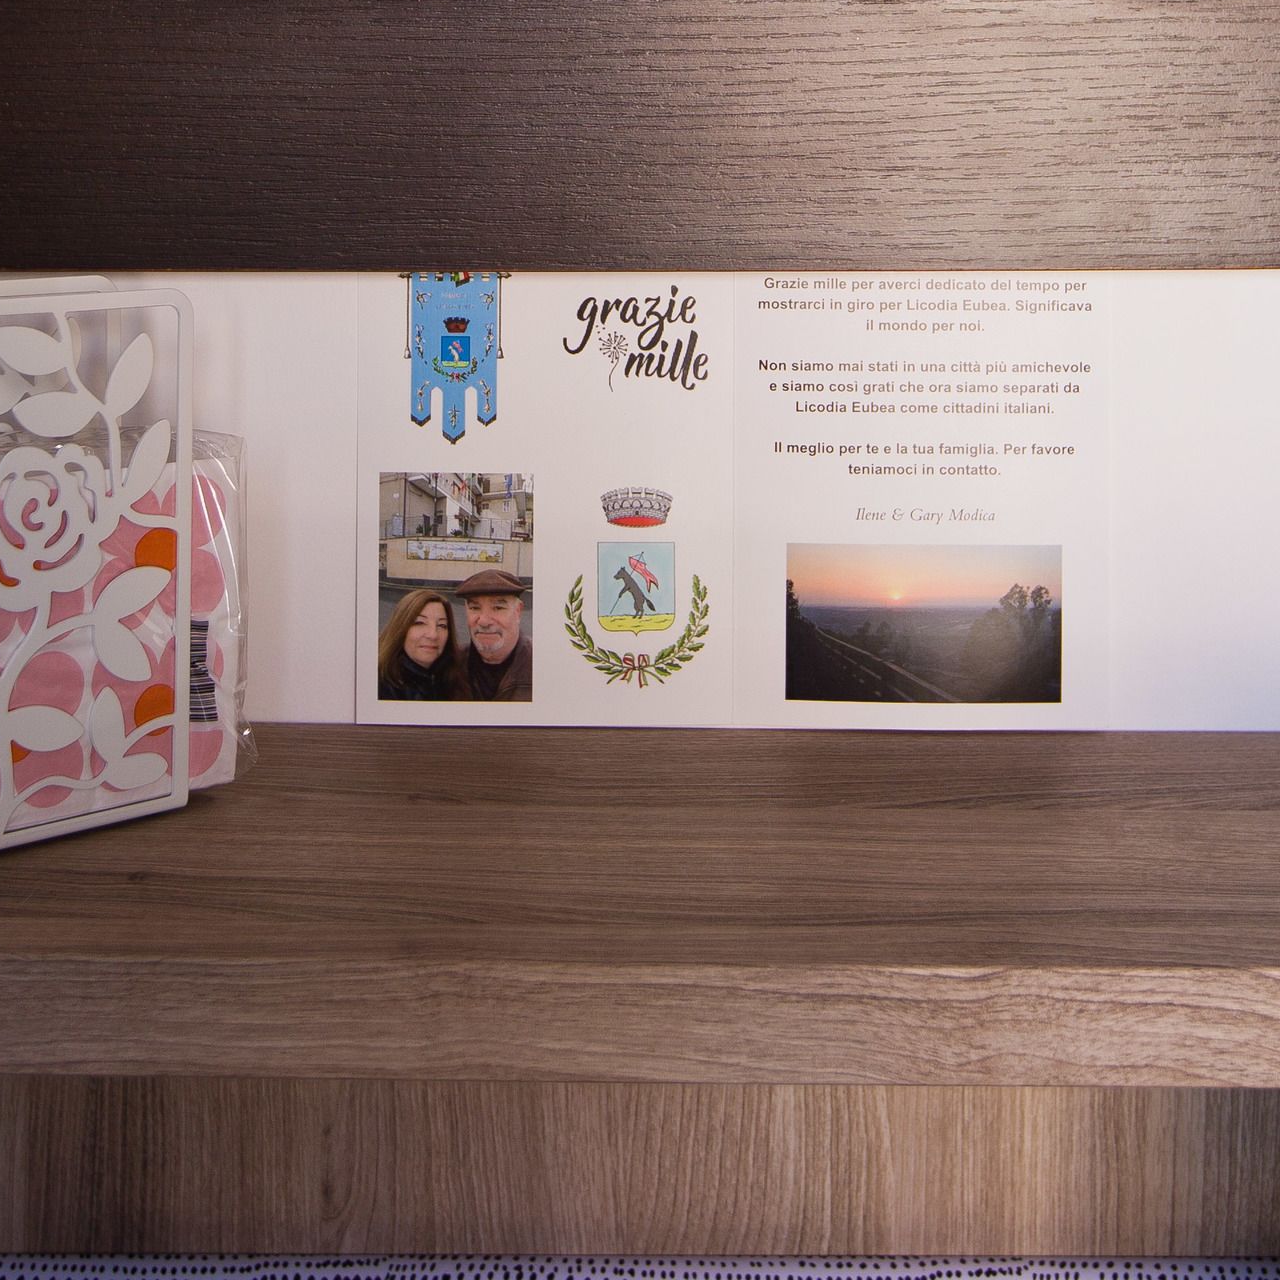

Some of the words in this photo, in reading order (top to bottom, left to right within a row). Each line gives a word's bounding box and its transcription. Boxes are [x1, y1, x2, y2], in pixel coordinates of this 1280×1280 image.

[764, 277, 809, 290] Grazie
[813, 277, 847, 290] mille
[851, 280, 875, 293] per
[878, 278, 921, 291] averci
[925, 279, 986, 291] dedicato
[990, 279, 1012, 291] del
[1015, 280, 1060, 294] tempo
[1064, 281, 1087, 294] per
[758, 298, 825, 311] mostrarci
[830, 299, 842, 311] in
[847, 299, 875, 314] giro
[879, 301, 902, 314] per
[906, 299, 958, 312] Licodia
[963, 300, 1010, 312] Eubea.
[1015, 300, 1093, 315] Significava
[563, 285, 696, 355] grazie
[866, 319, 874, 331] il
[878, 319, 927, 332] mondo
[932, 322, 955, 335] per
[959, 320, 985, 332] noi.
[624, 330, 709, 391] mille
[758, 359, 787, 372] Non
[791, 360, 834, 372] siamo
[838, 360, 864, 372] mai
[868, 360, 898, 373] stati
[903, 360, 916, 373] in
[920, 362, 946, 373] una
[950, 360, 981, 373] città
[985, 361, 1007, 376] più
[1011, 361, 1091, 373] amichevole
[769, 382, 777, 393] e
[782, 380, 825, 393] siamo
[829, 380, 858, 393] così
[863, 380, 894, 396] grati
[899, 381, 924, 393] che
[929, 383, 952, 393] ora
[956, 381, 999, 394] siamo
[1003, 381, 1059, 397] separati
[1063, 381, 1080, 394] da
[796, 401, 847, 413] Licodia
[852, 401, 896, 414] Eubea
[900, 403, 938, 414] come
[943, 401, 999, 415] cittadini
[1004, 401, 1055, 415] italiani.
[774, 442, 782, 453] Il
[786, 442, 834, 458] meglio
[839, 445, 862, 458] per
[866, 443, 879, 455] te
[883, 445, 891, 455] e
[896, 443, 908, 455] la
[912, 443, 934, 455] tua
[938, 443, 999, 458] famiglia.
[1003, 443, 1027, 455] Per
[1031, 443, 1075, 455] favore
[848, 463, 917, 476] teniamoci
[922, 463, 935, 476] in
[939, 464, 1001, 476] contatto.
[856, 508, 886, 522] Ilene
[891, 508, 904, 522] &
[910, 508, 943, 525] Gary
[948, 508, 996, 522] Modica
